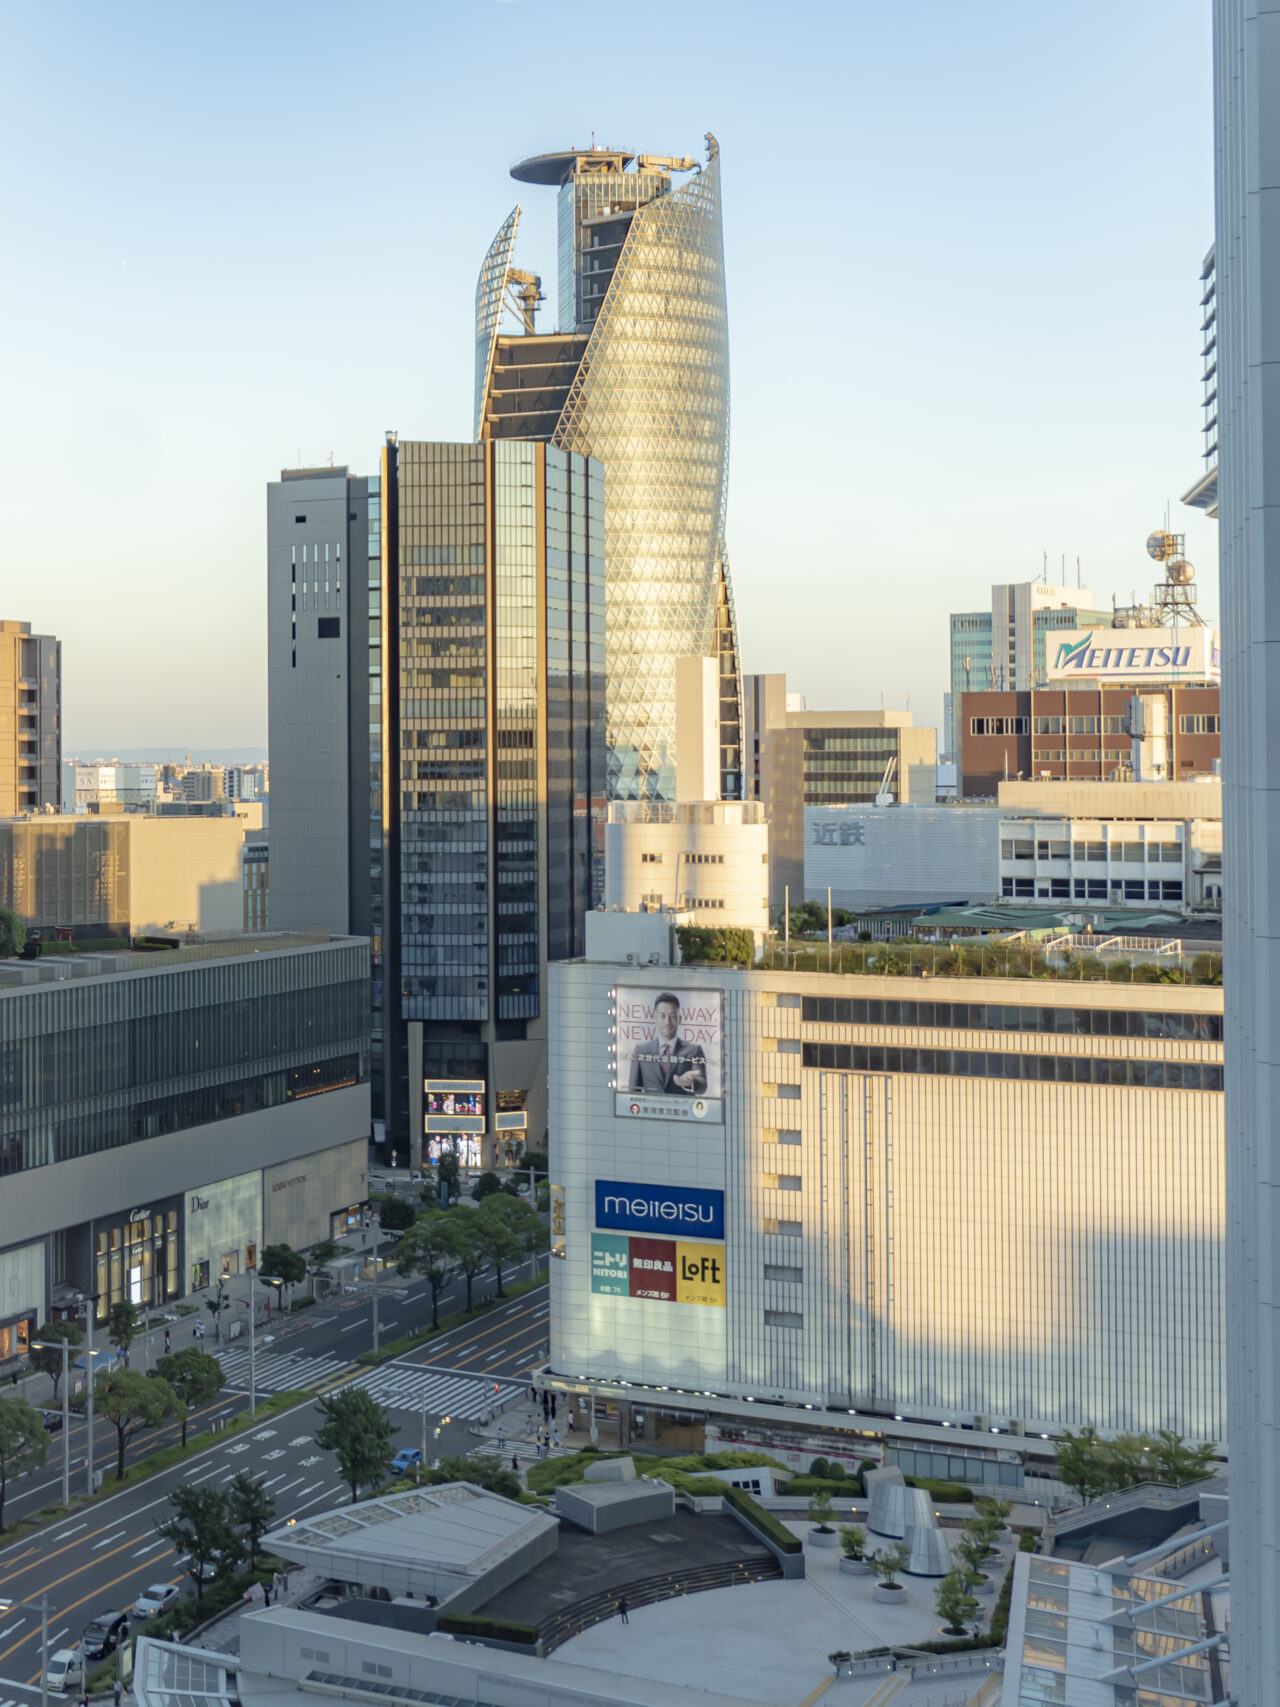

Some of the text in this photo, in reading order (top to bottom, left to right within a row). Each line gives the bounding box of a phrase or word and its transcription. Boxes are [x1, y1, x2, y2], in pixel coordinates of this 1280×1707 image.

[1054, 631, 1192, 669] MEITETSU
[813, 822, 865, 846] 近鉄
[619, 1004, 718, 1022] NEW WAY.
[619, 1025, 718, 1045] NEW DAY.
[191, 1196, 210, 1213] Dior
[604, 1196, 714, 1222] meitetsu
[129, 1208, 152, 1223] Cartier
[592, 1250, 628, 1268] ニトリ
[632, 1257, 674, 1272] 無印良品
[592, 1268, 628, 1279] NITORI
